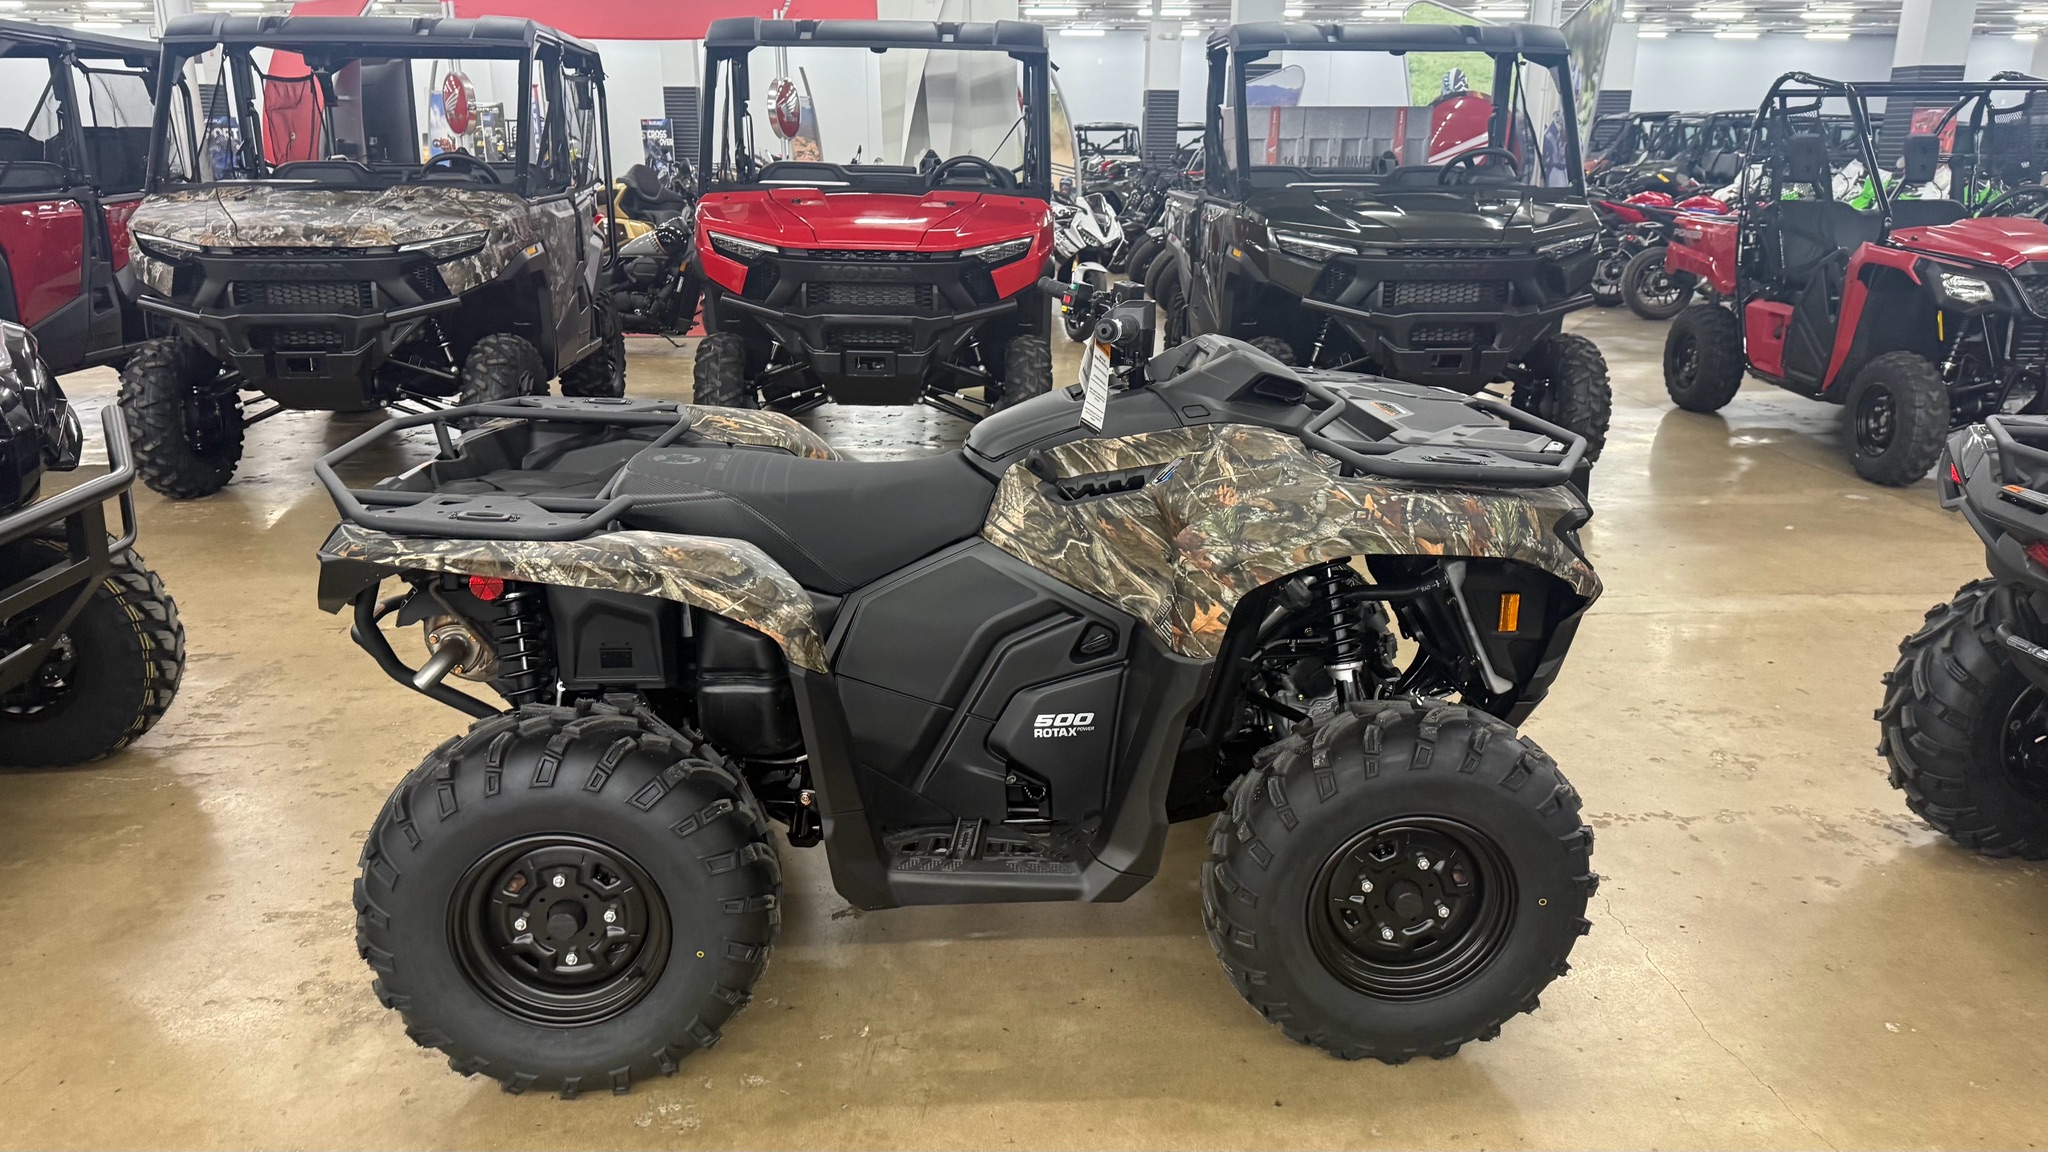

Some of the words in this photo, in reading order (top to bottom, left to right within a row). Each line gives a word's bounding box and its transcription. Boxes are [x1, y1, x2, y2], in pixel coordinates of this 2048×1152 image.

[647, 129, 667, 139] CROSS
[1034, 712, 1095, 727] 500
[1034, 727, 1077, 738] ROTAX
